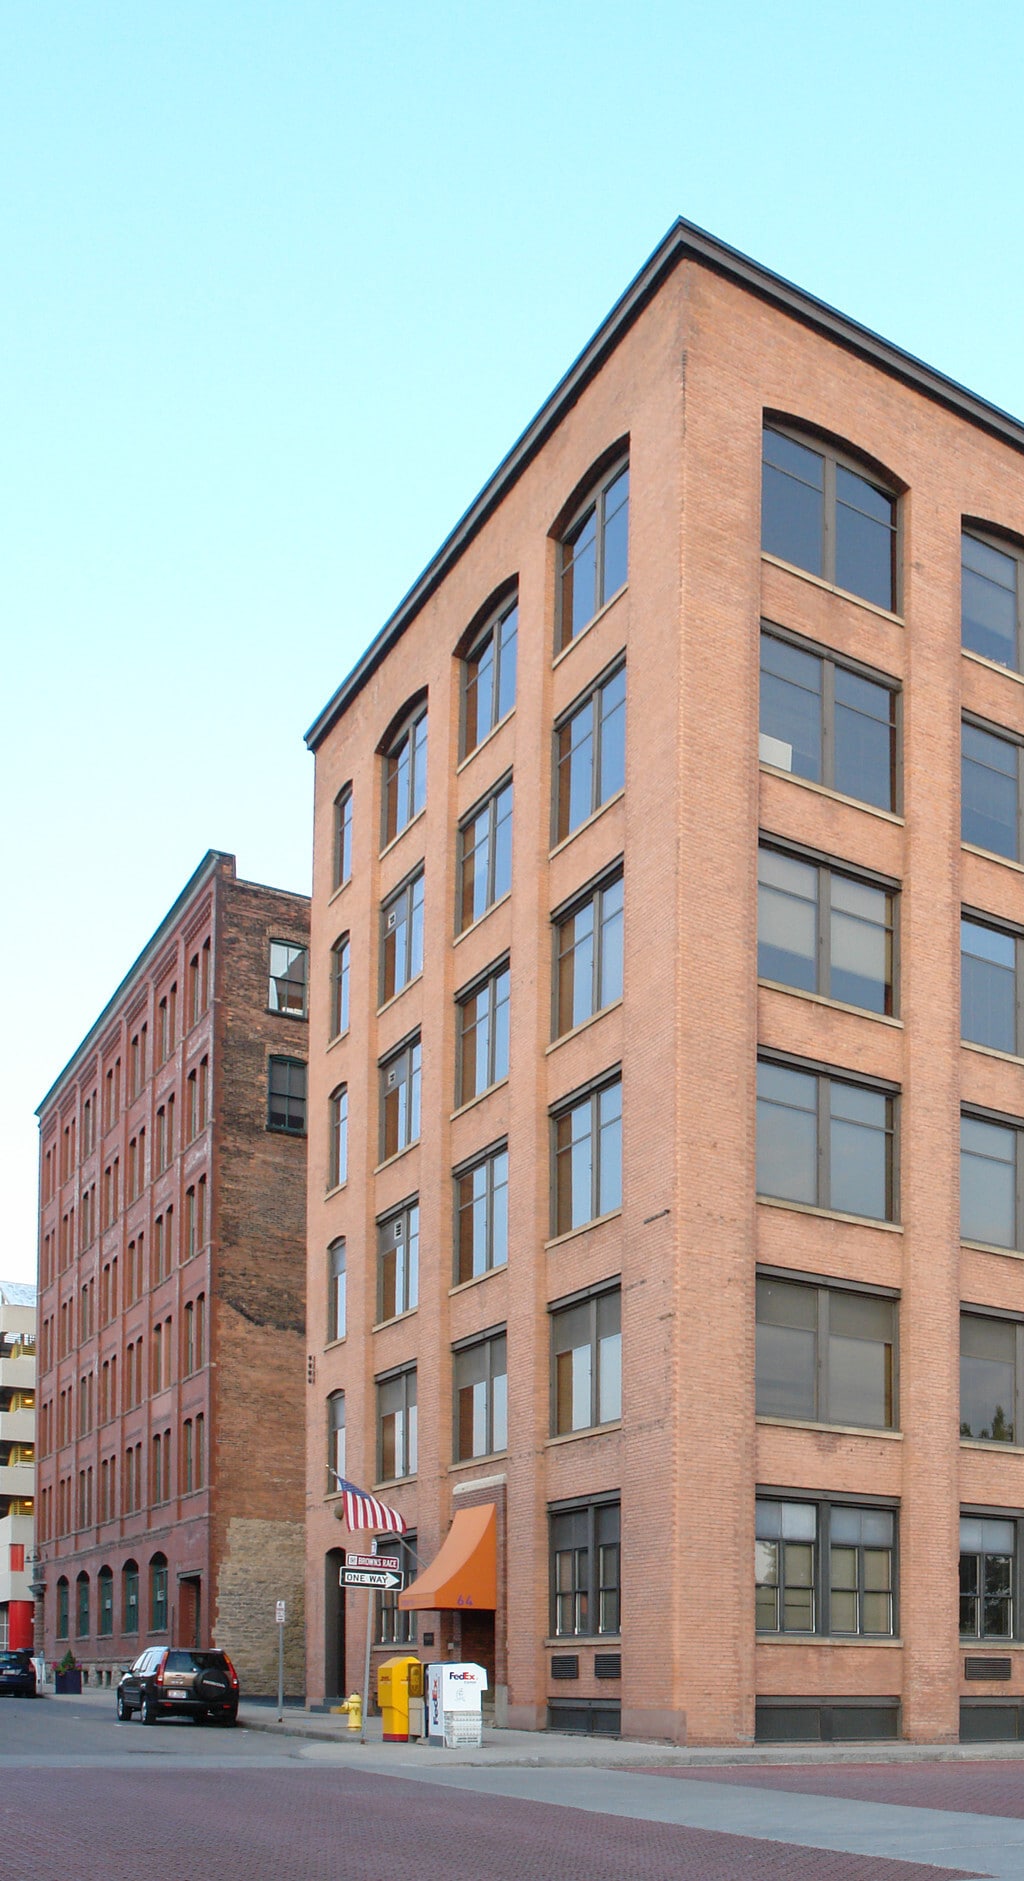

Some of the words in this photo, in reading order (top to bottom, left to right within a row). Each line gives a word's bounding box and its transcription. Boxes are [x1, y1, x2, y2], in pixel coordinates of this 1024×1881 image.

[382, 1558, 397, 1569] RACE
[346, 1573, 366, 1582] ONE
[369, 1575, 389, 1584] WAY
[456, 1594, 474, 1607] 64
[449, 1671, 476, 1681] FedEx
[431, 1679, 439, 1726] FedEx
